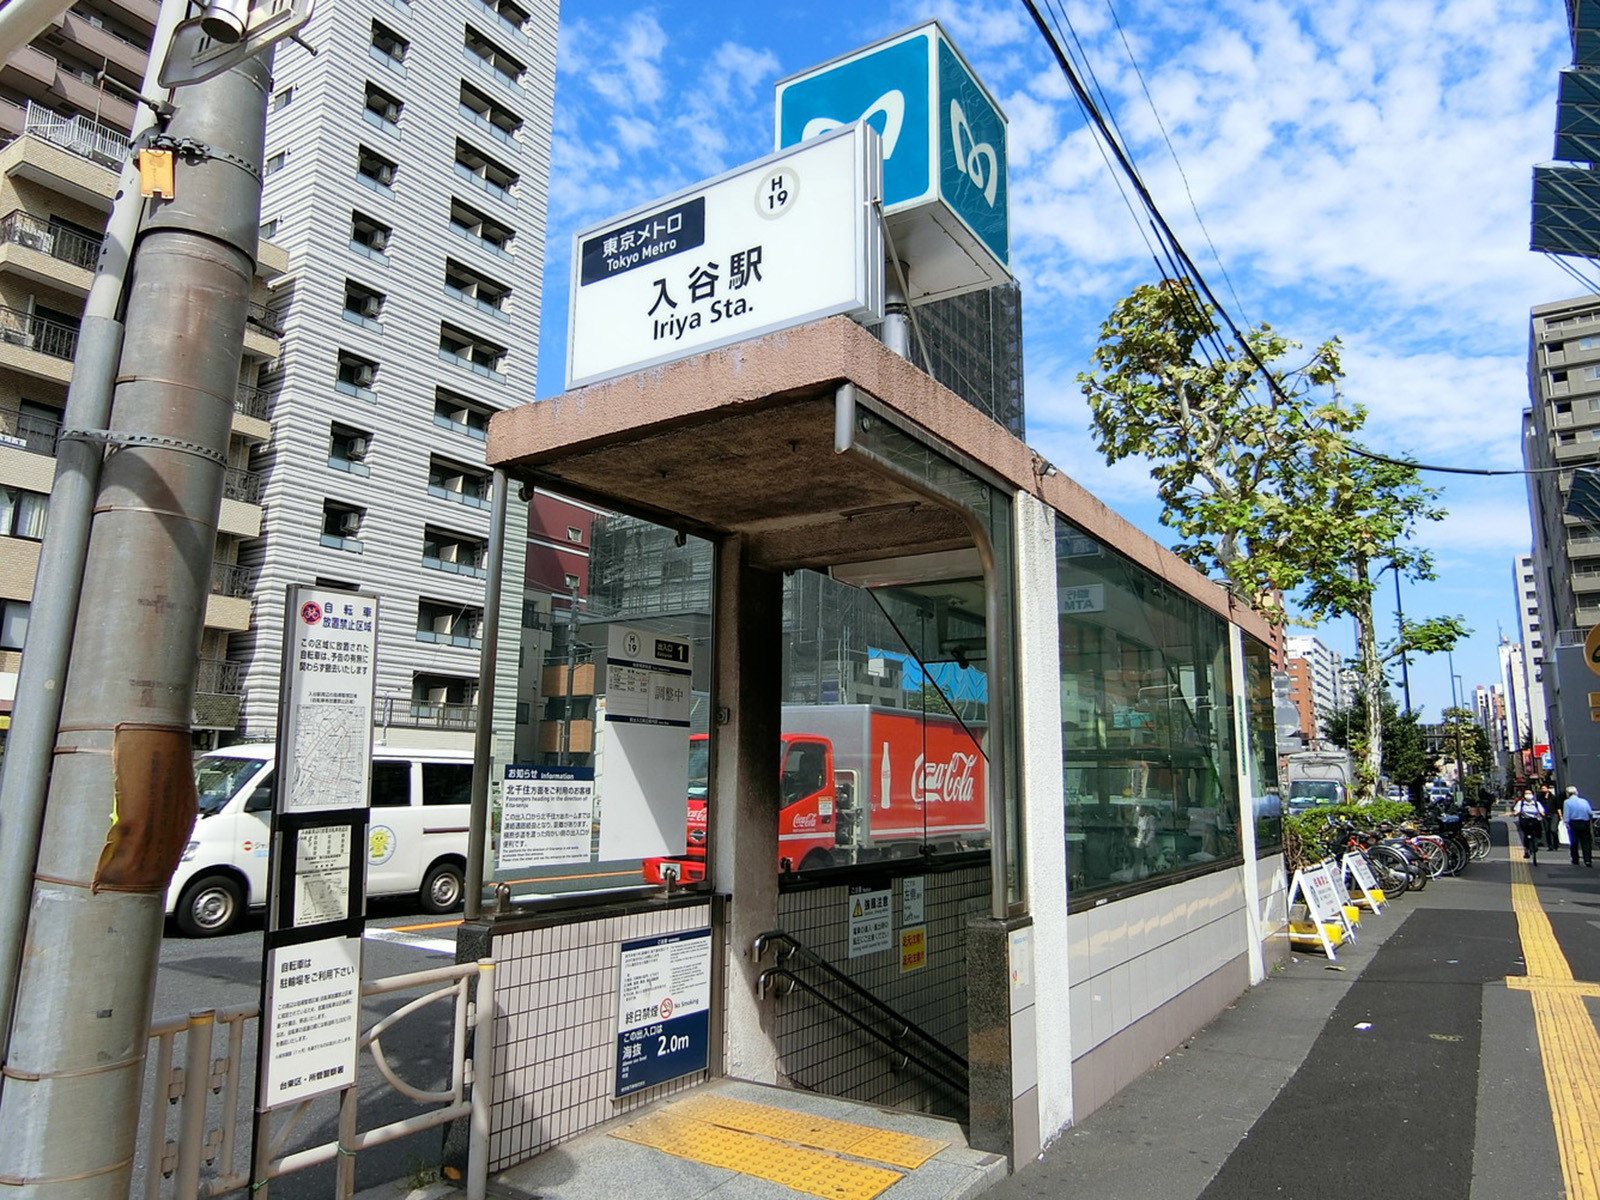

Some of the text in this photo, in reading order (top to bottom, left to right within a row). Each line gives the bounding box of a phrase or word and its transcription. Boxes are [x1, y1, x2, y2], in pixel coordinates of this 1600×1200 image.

[771, 175, 783, 192] H
[768, 190, 788, 210] 19
[602, 212, 682, 258] 東京メトロ
[606, 238, 677, 272] Tokyo Metro
[647, 246, 762, 317] 入谷駅
[653, 298, 754, 341] Iriya Sta.
[322, 617, 372, 632] 放置禁止区域
[628, 643, 637, 653] 19
[678, 645, 684, 660] 1
[508, 768, 574, 780] お知らせ Information
[506, 784, 591, 795] 北千住方面をご利用のお客様
[281, 958, 311, 973] 自転車は
[280, 966, 355, 989] 駐輪場をご利用下さい
[681, 998, 699, 1008] Smoking
[625, 1005, 659, 1024] 終日禁煙
[623, 1024, 663, 1043] この出入口は
[622, 1035, 689, 1060] 海抜 2.0m
